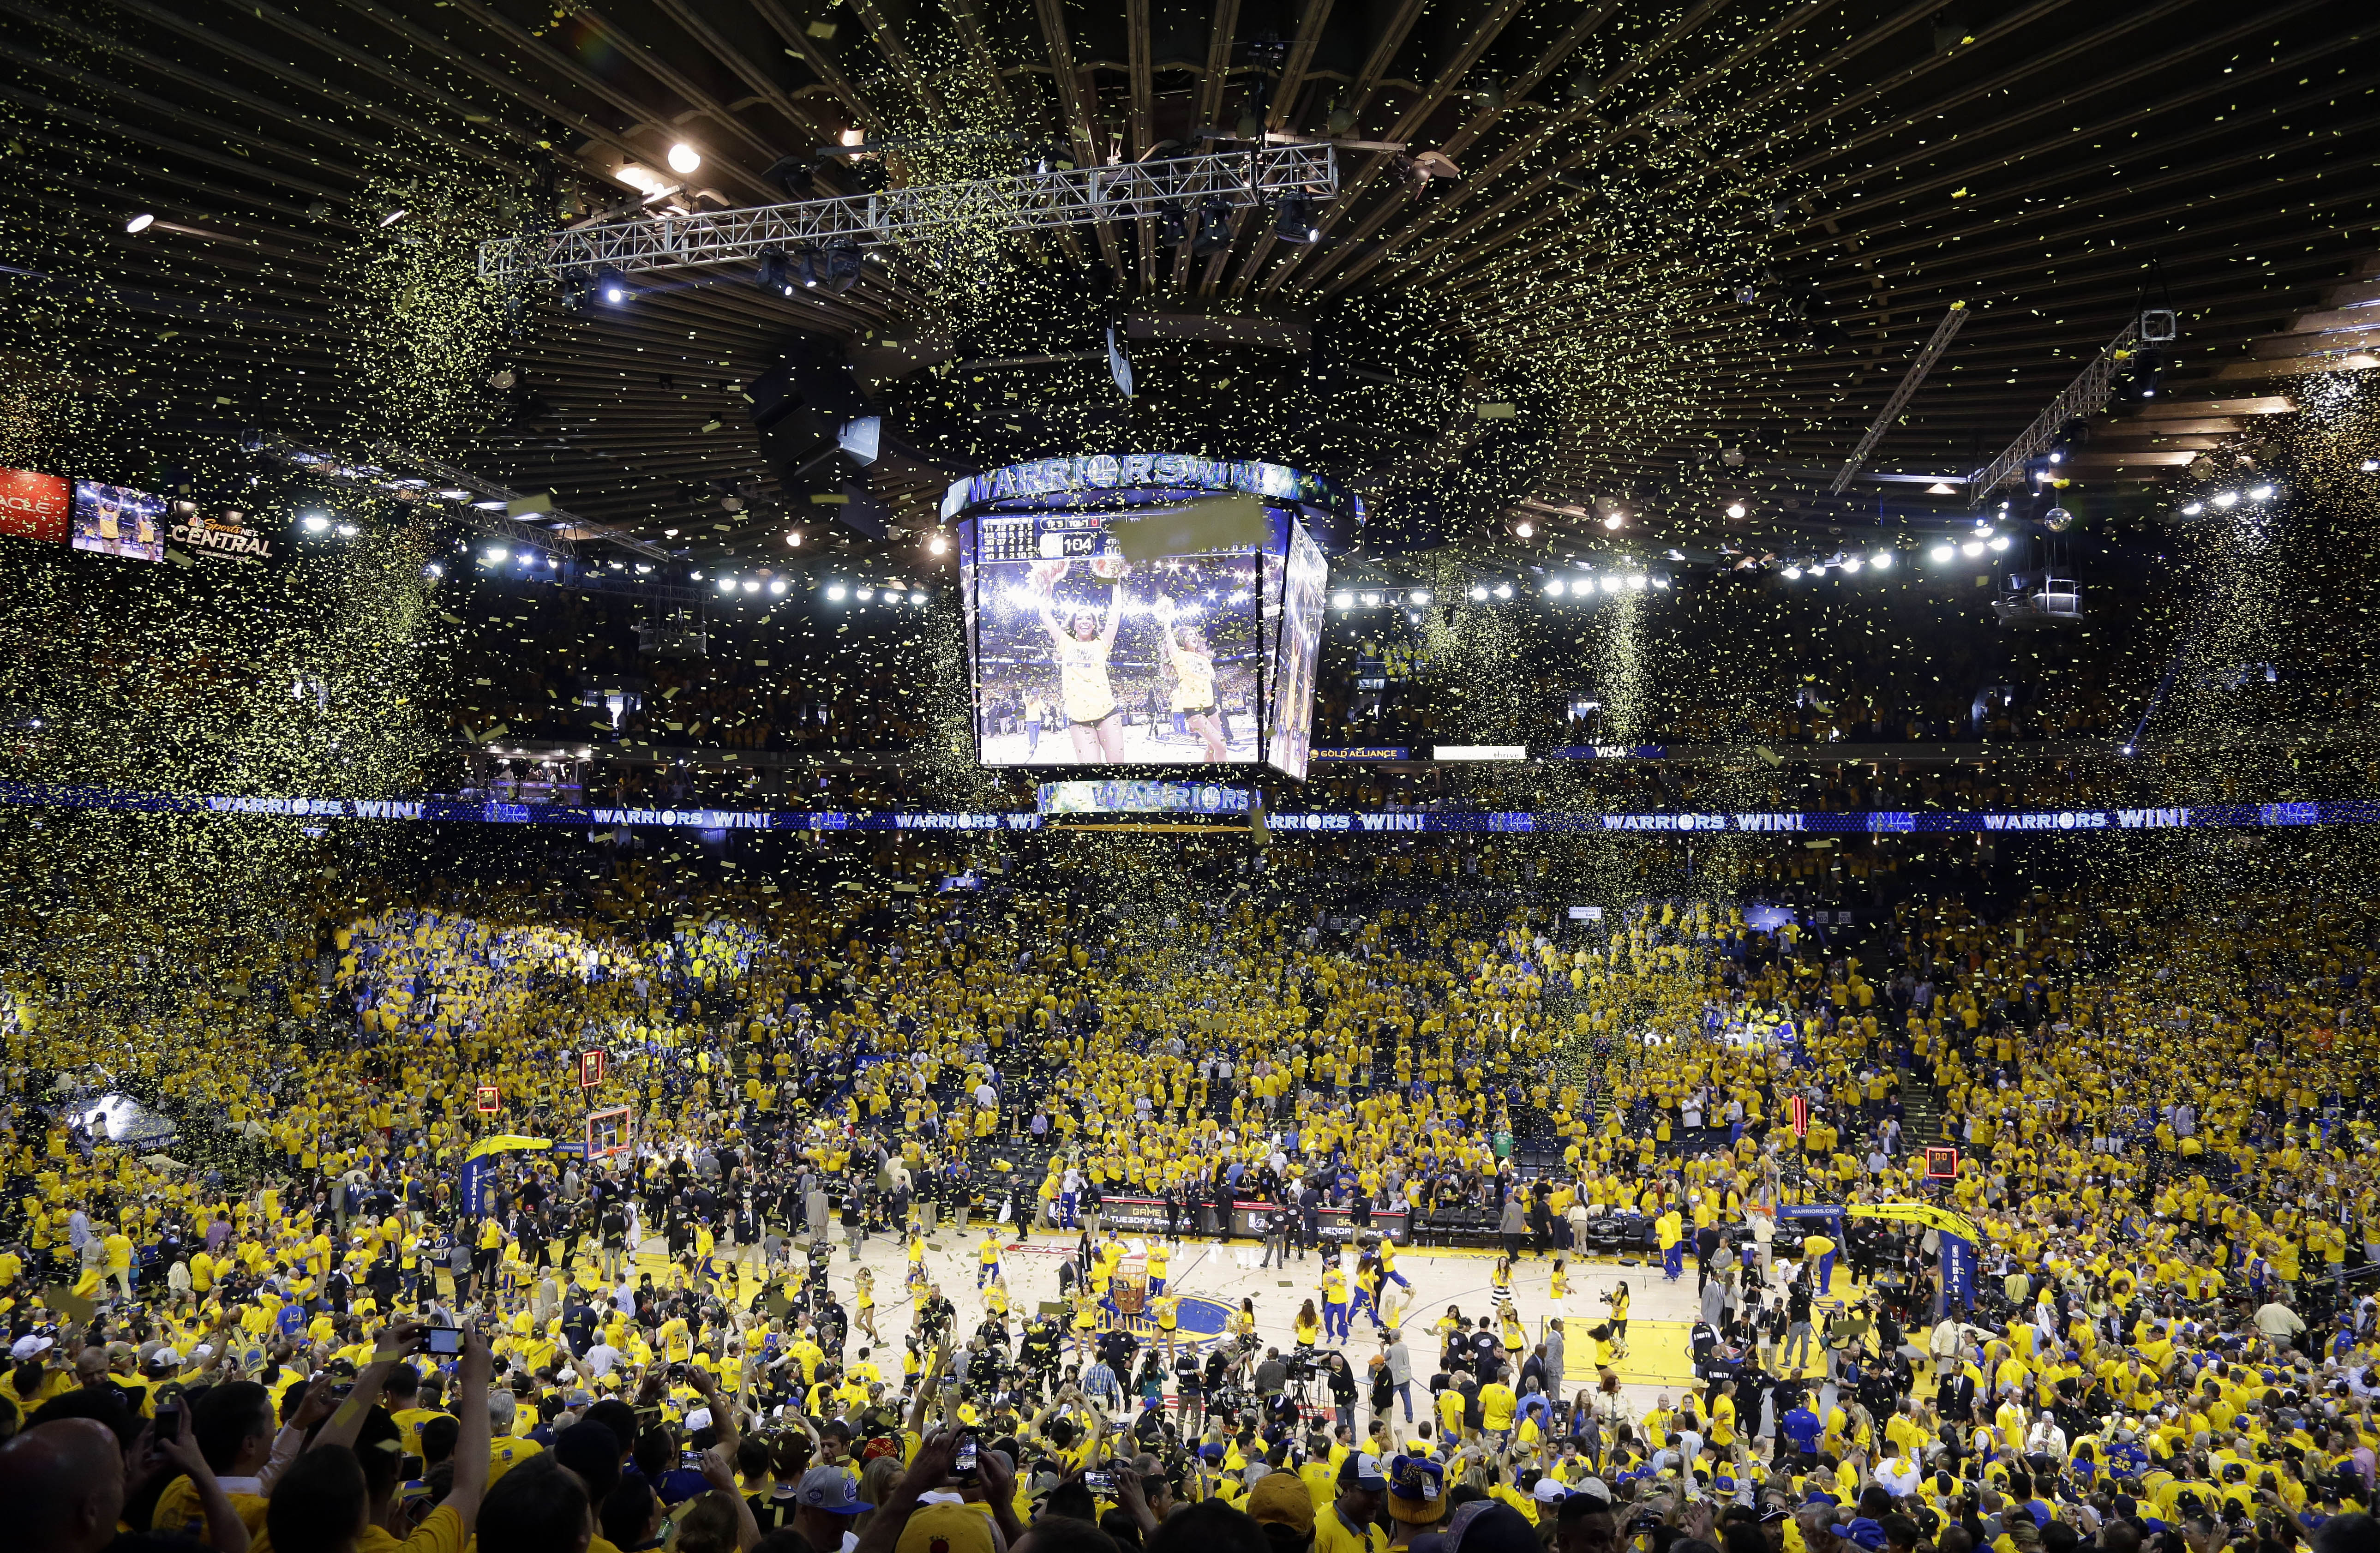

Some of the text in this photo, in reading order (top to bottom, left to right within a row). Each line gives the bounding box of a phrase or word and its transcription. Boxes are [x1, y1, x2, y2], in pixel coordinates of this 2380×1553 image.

[172, 525, 273, 557] CENTRAL
[1064, 539, 1092, 551] 104
[1593, 746, 1625, 757] VISA
[209, 797, 423, 819] WARRIORS WIN!
[593, 809, 770, 828] WARRIORS WIN!
[894, 814, 998, 828] WARRIORS
[1264, 814, 1425, 830] RRIORS WIN!
[1602, 814, 1804, 831] WARRIORS WIN!
[1983, 808, 2189, 829] WARRIORS WIN!
[471, 1198, 477, 1211] TV
[1110, 1215, 1153, 1224] TUESDAY
[1133, 1208, 1162, 1217] GAME
